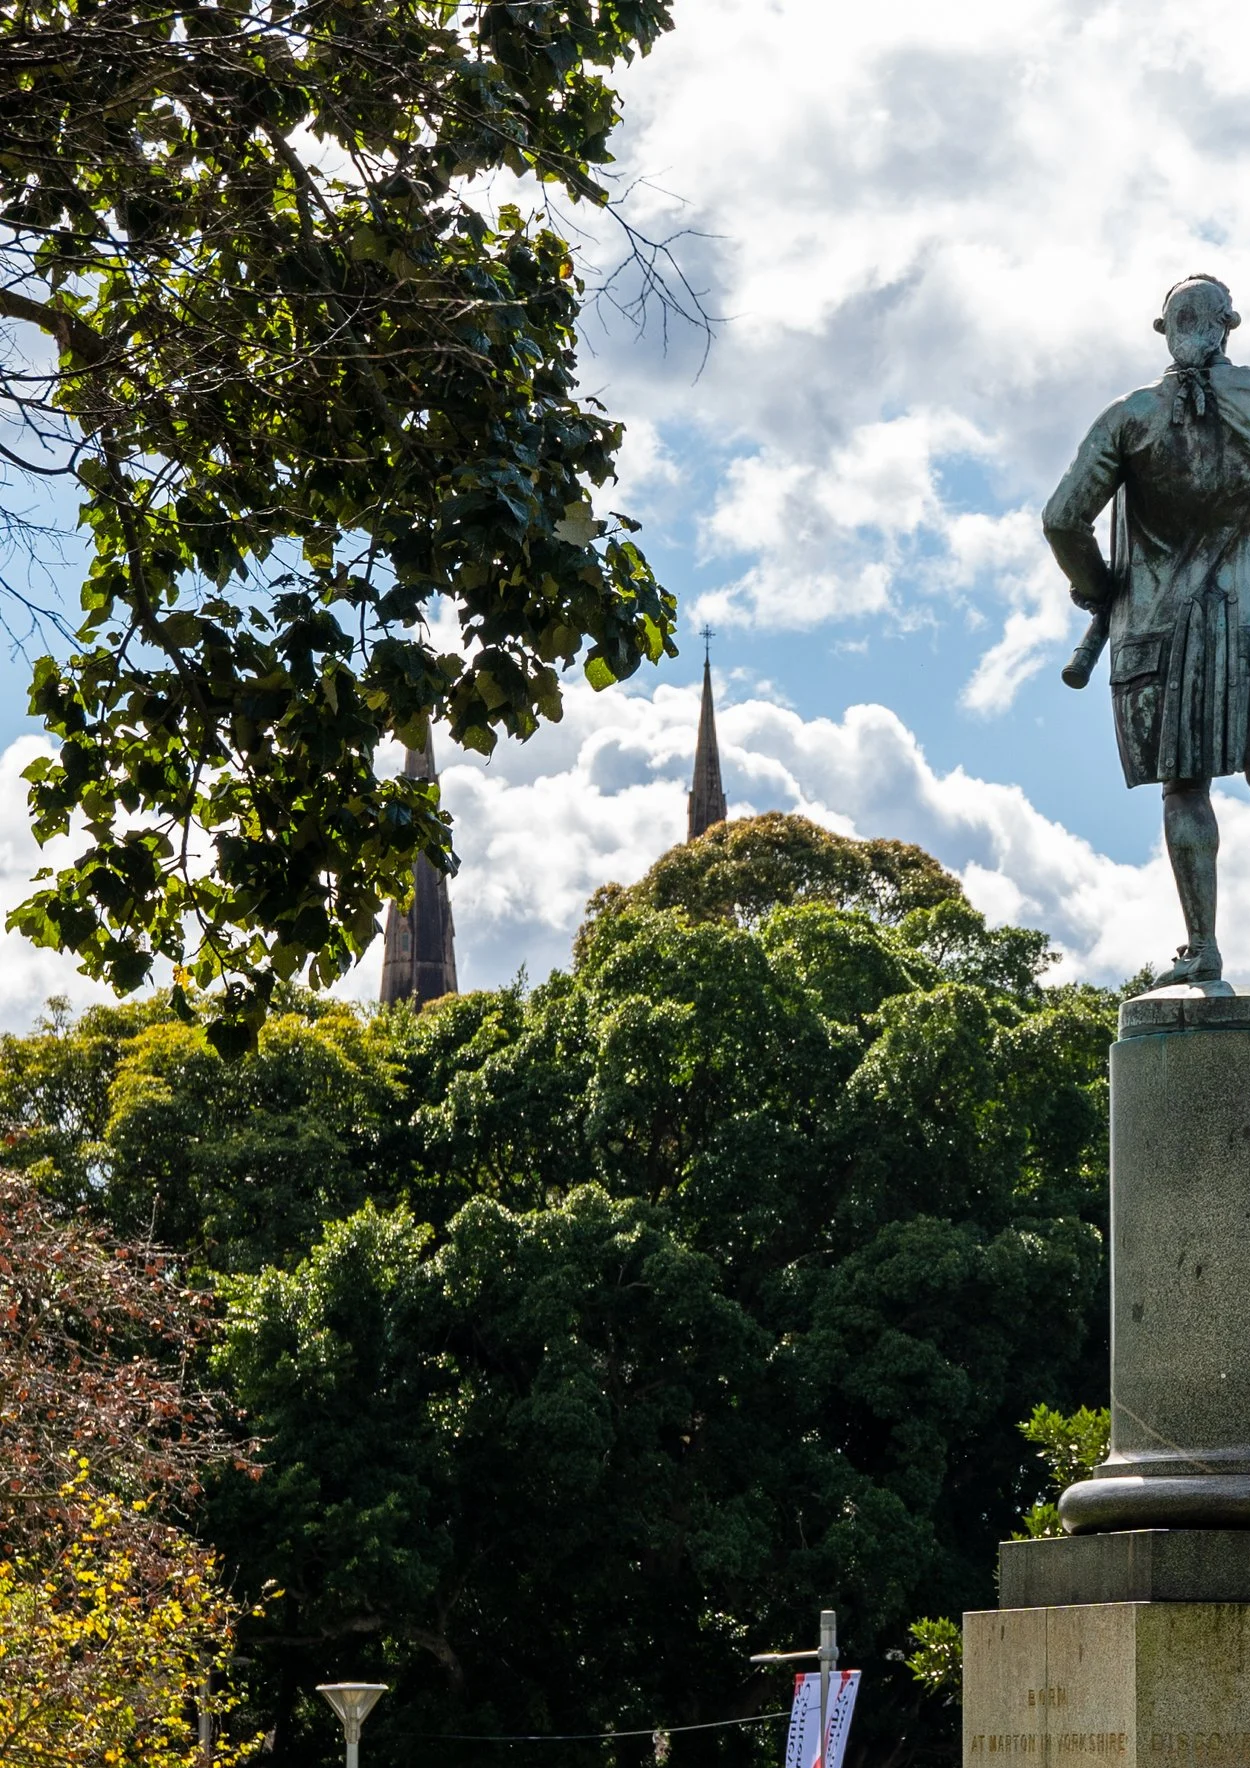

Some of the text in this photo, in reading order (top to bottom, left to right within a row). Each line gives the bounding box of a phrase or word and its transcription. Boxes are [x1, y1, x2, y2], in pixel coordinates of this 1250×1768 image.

[1028, 1687, 1067, 1707] BORN
[971, 1735, 985, 1752] AT
[989, 1735, 1035, 1752] MARTON
[1057, 1732, 1127, 1752] YORKSHIRE
